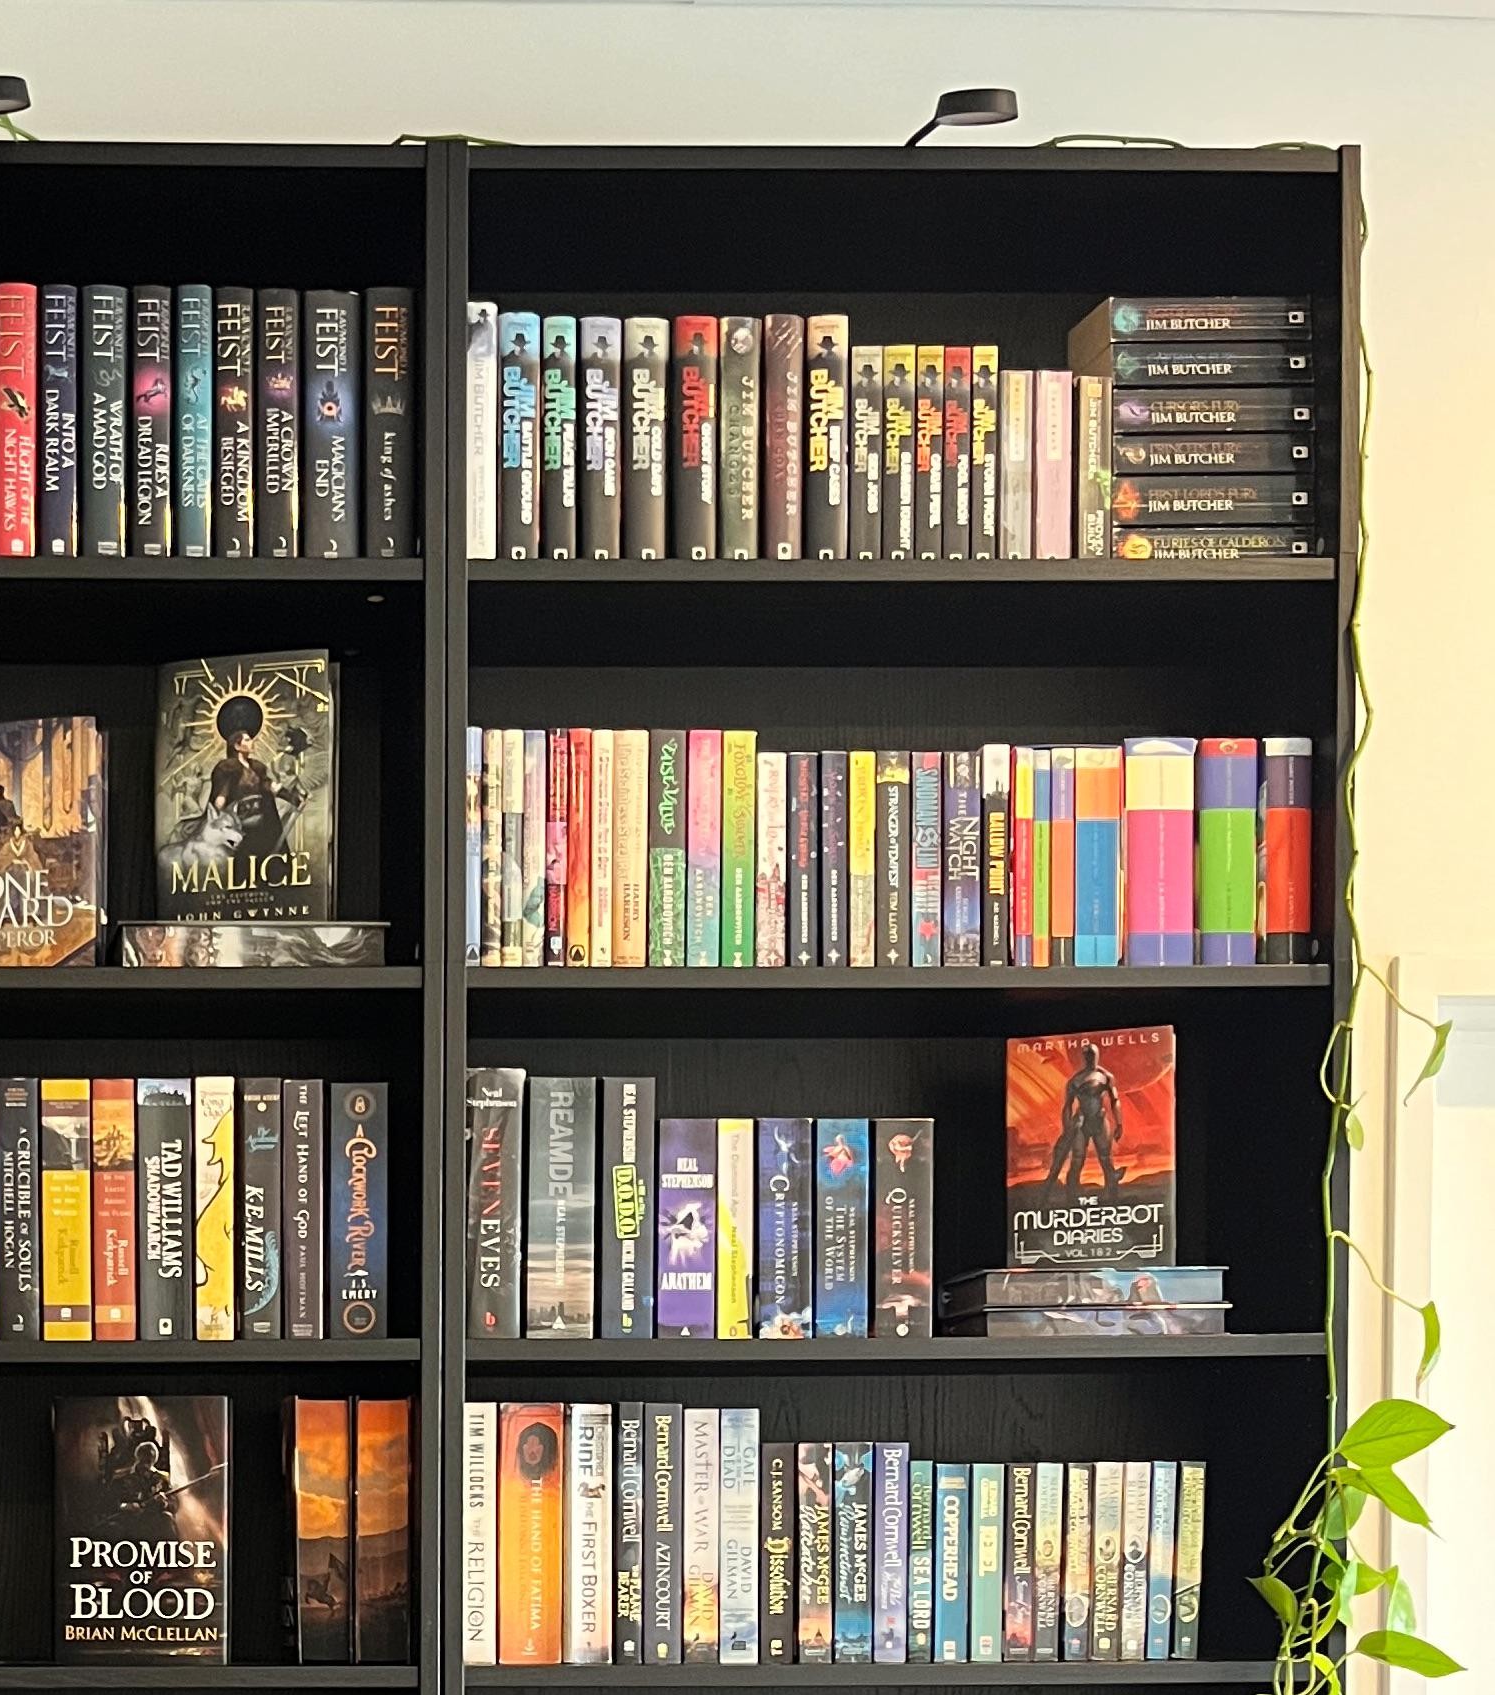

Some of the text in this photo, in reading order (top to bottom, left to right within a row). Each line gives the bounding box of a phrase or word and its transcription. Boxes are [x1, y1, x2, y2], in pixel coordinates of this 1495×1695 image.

[316, 309, 338, 377] FEIST
[1146, 318, 1231, 330] JIM BUTCHER
[45, 390, 59, 492] DARK REALM
[94, 410, 106, 489] MAD GOD
[504, 367, 521, 470] BUTCHER
[809, 369, 828, 472] BUTCHER
[1152, 412, 1235, 423] JIM BUTCHER
[171, 852, 311, 895] MALICE
[949, 818, 961, 882] WATCH
[962, 817, 979, 881] NIGHT
[233, 906, 310, 919] GWYNNE
[1017, 1033, 1161, 1054] MARTHA WELLS
[159, 1140, 181, 1278] TAD WILLIAMS
[480, 1128, 501, 1288] SEVENEVES
[661, 1174, 713, 1188] STEPHENSON
[1079, 1197, 1098, 1205] THE
[18, 1137, 31, 1292] CRUCIBLE SOULS
[770, 1176, 789, 1306] CRYPTONOMICON
[885, 1188, 906, 1284] QUICKSILVER
[1014, 1204, 1164, 1230] MURDERBOT
[1054, 1229, 1123, 1245] DIARIES
[342, 1290, 377, 1299] EMERY
[661, 1273, 712, 1290] ANATHEM
[469, 1436, 484, 1508] WILLOCKS
[656, 1416, 673, 1532] Bernard Cornwell
[69, 1538, 216, 1568] PROMISE
[130, 1571, 152, 1584] OF
[583, 1523, 596, 1633] FIRST BOXER
[942, 1496, 959, 1601] COPPERHEAD
[70, 1584, 214, 1620] BLOOD
[468, 1542, 484, 1641] RELIGION
[656, 1542, 671, 1629] AZINCOURT
[912, 1555, 929, 1629] SEA LORD
[65, 1626, 115, 1641] BRIAN
